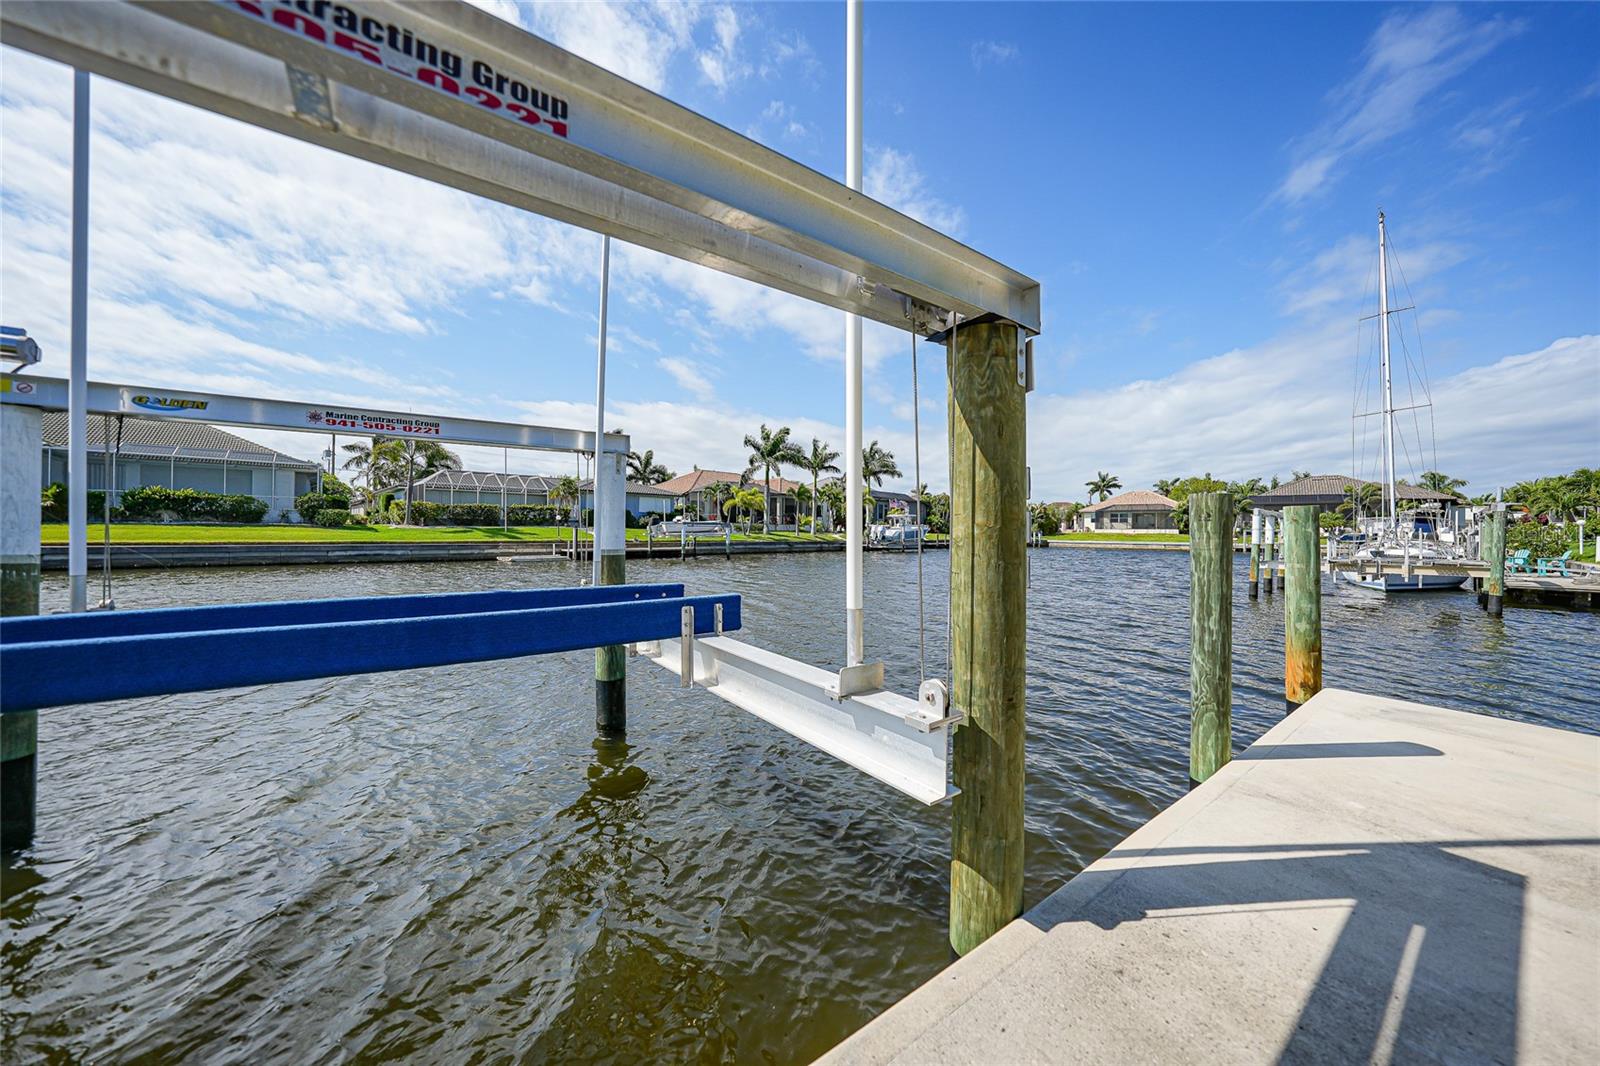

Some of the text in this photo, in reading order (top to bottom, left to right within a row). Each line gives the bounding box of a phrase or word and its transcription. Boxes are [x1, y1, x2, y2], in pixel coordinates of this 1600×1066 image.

[472, 60, 569, 121] Group
[325, 411, 440, 428] Marine Contracting Group
[325, 418, 440, 435] 941-505-0221
